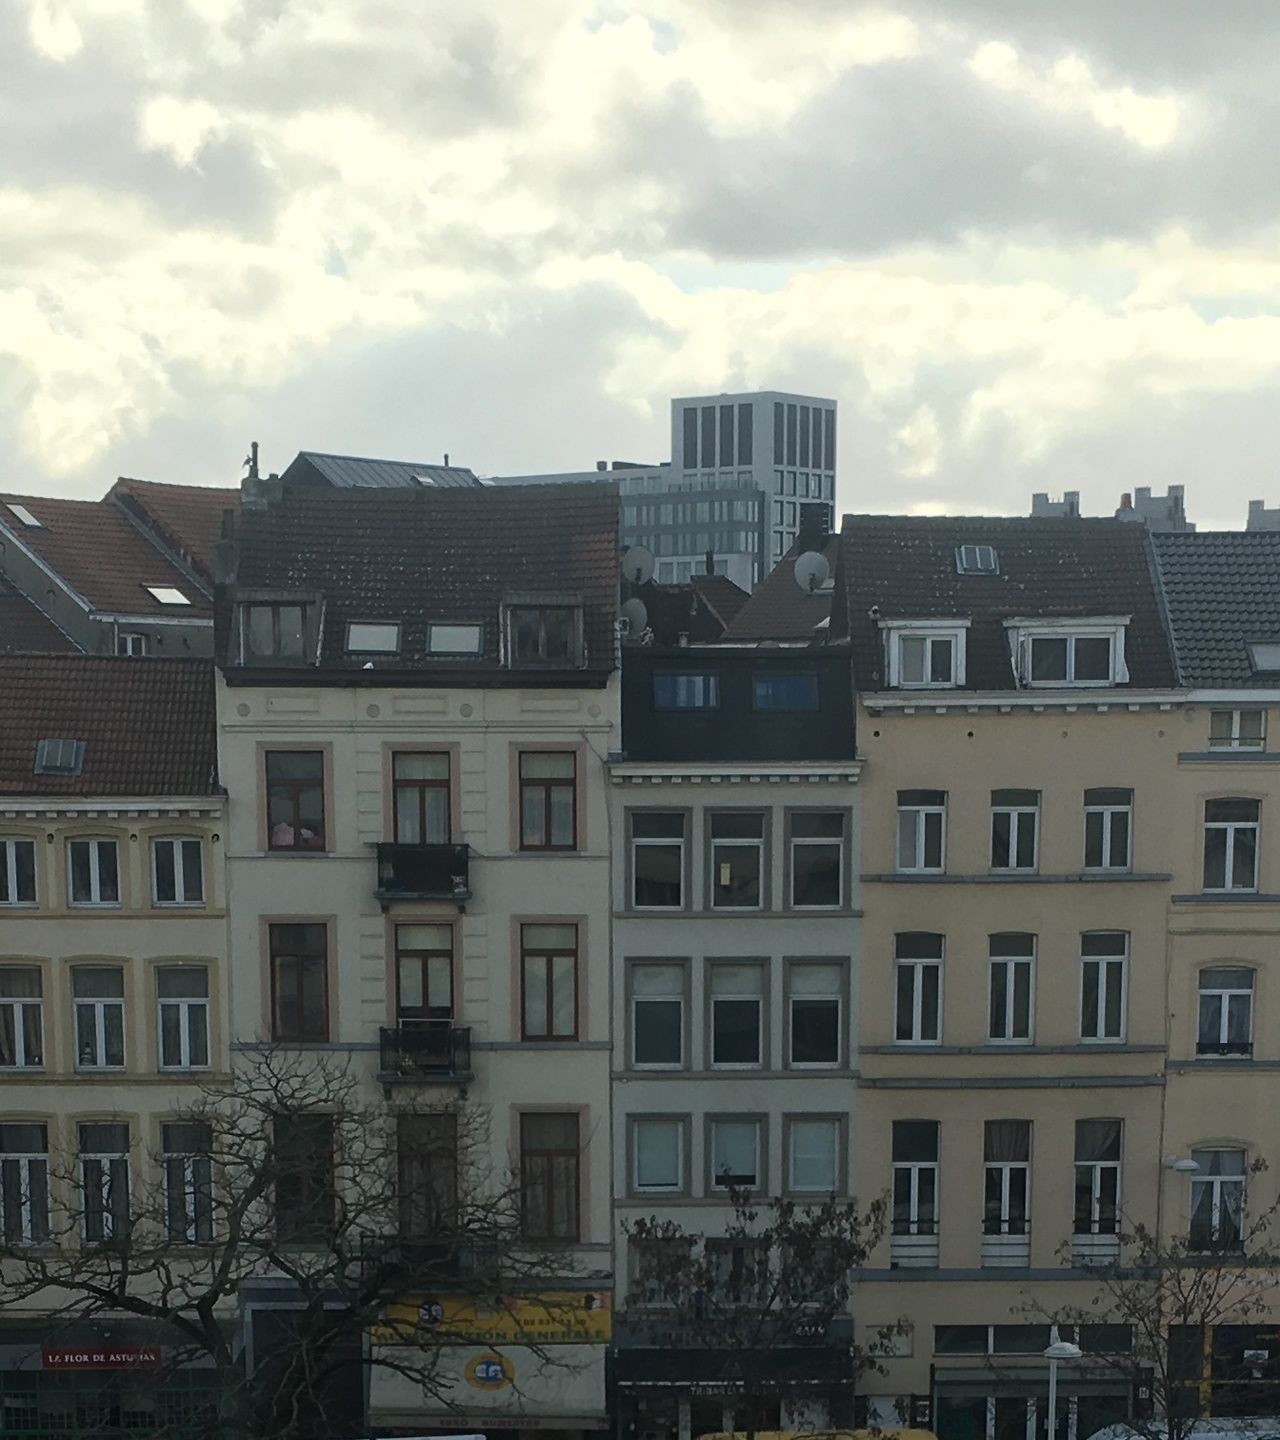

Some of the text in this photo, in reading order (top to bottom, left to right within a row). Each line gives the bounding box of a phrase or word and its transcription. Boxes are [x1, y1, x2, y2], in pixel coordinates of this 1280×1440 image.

[48, 1354, 61, 1363] LA
[65, 1354, 89, 1363] FLOR
[93, 1354, 106, 1362] DE
